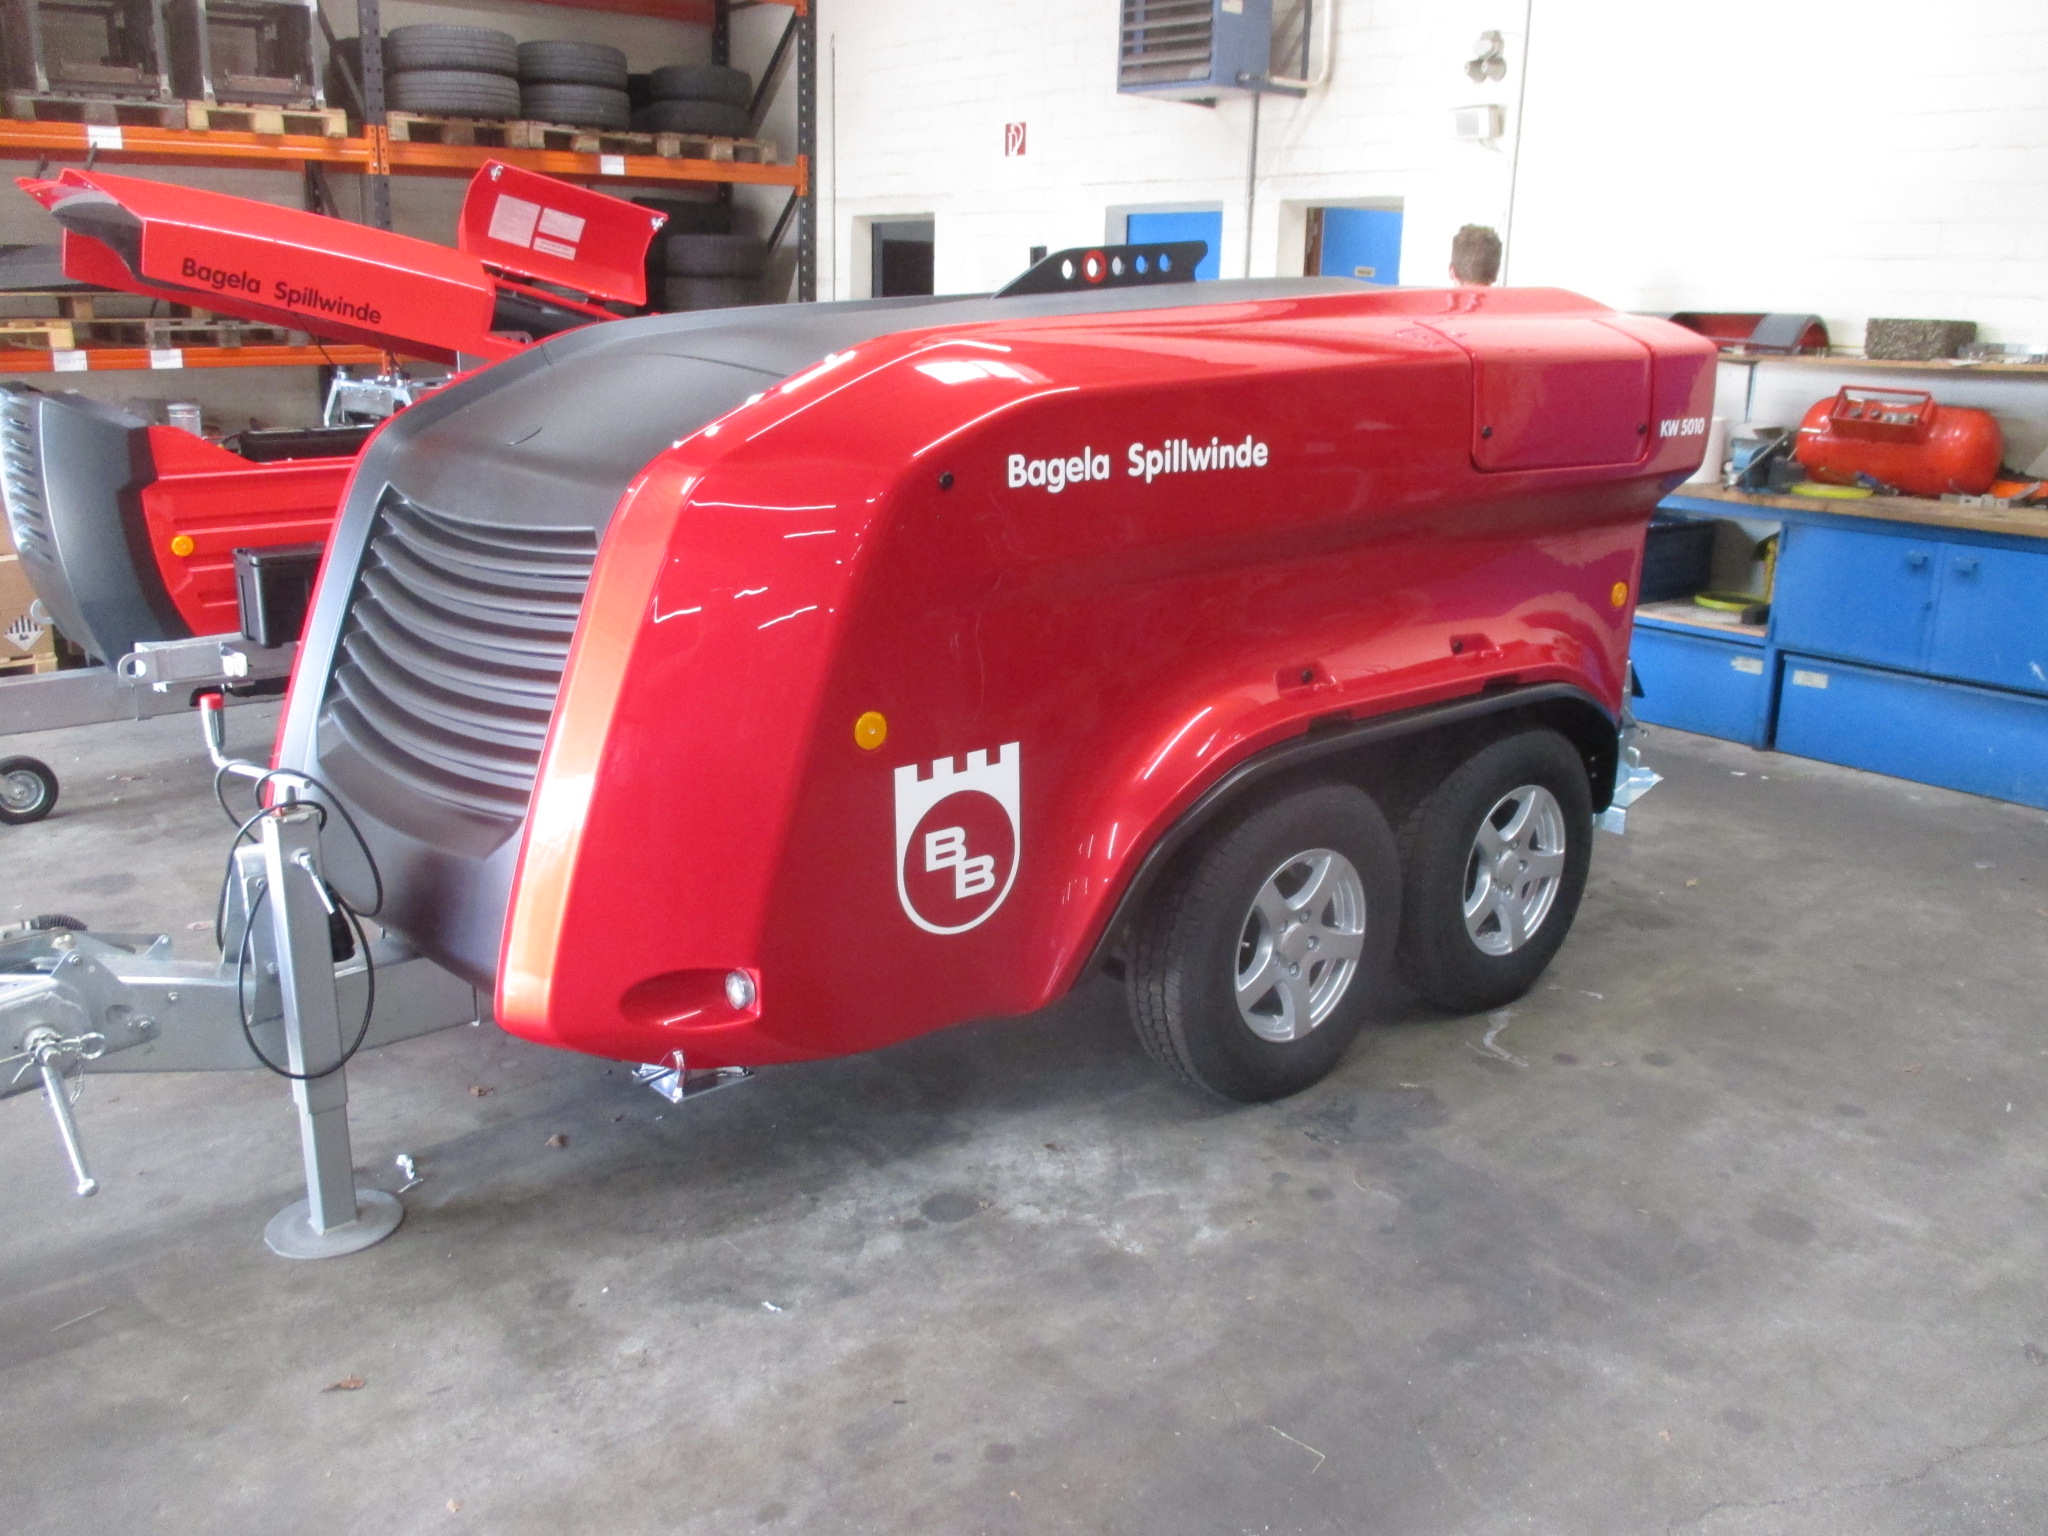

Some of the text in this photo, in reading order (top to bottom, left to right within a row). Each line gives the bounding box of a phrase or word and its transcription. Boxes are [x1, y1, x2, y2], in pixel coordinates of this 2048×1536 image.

[181, 257, 382, 325] Bagela Spillwinde
[1660, 417, 1705, 438] KW 5010
[1007, 434, 1269, 494] Bagela Spillwinde
